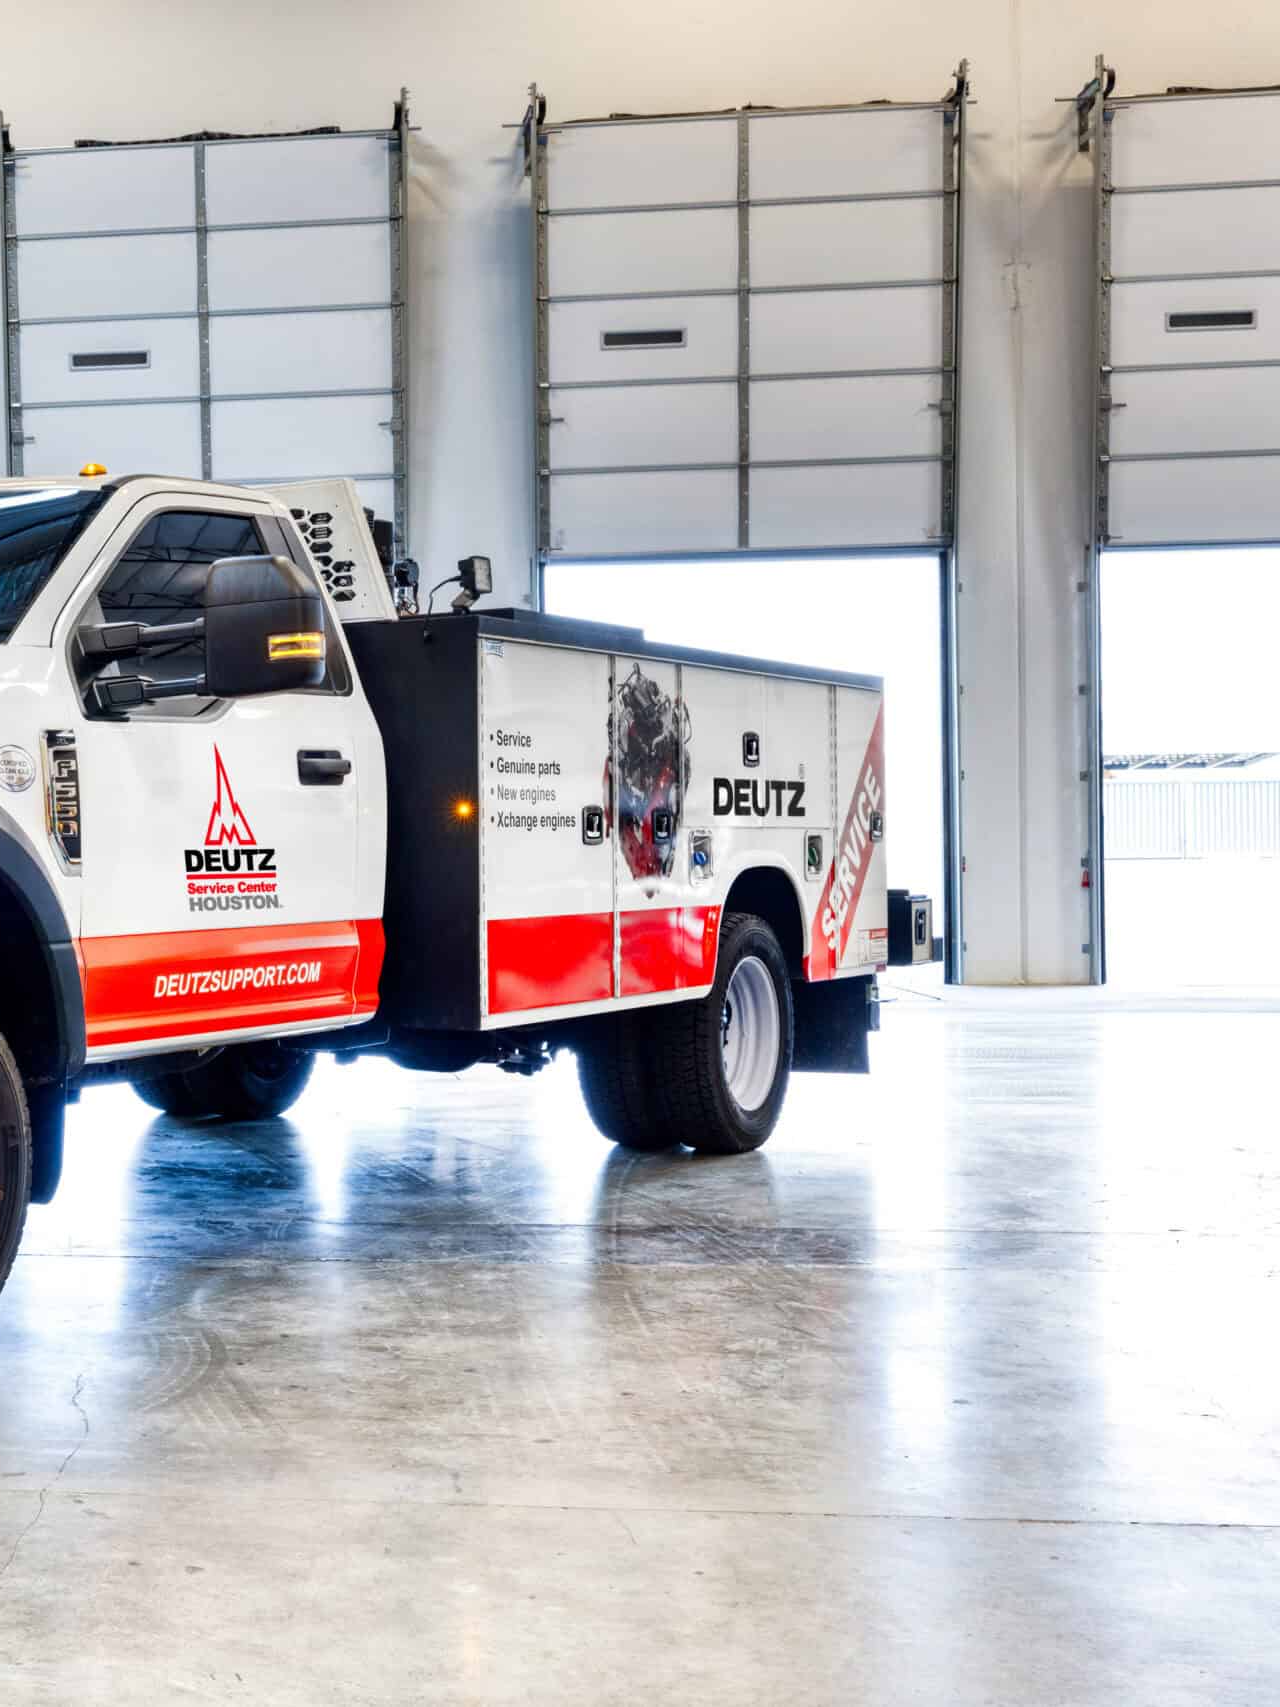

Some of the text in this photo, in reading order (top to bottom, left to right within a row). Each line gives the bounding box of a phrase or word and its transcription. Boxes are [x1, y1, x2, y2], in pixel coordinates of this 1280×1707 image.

[496, 730, 532, 748] Service
[496, 757, 561, 779] Genuine parts
[497, 784, 557, 805] New engines
[713, 777, 806, 817] DEUTZ
[497, 812, 576, 831] Xchange engines
[184, 848, 277, 873] DEUTZ
[821, 764, 881, 950] SERVICE
[187, 881, 277, 895] Service Center
[154, 961, 322, 998] DEUTZSUPPORT.COM
